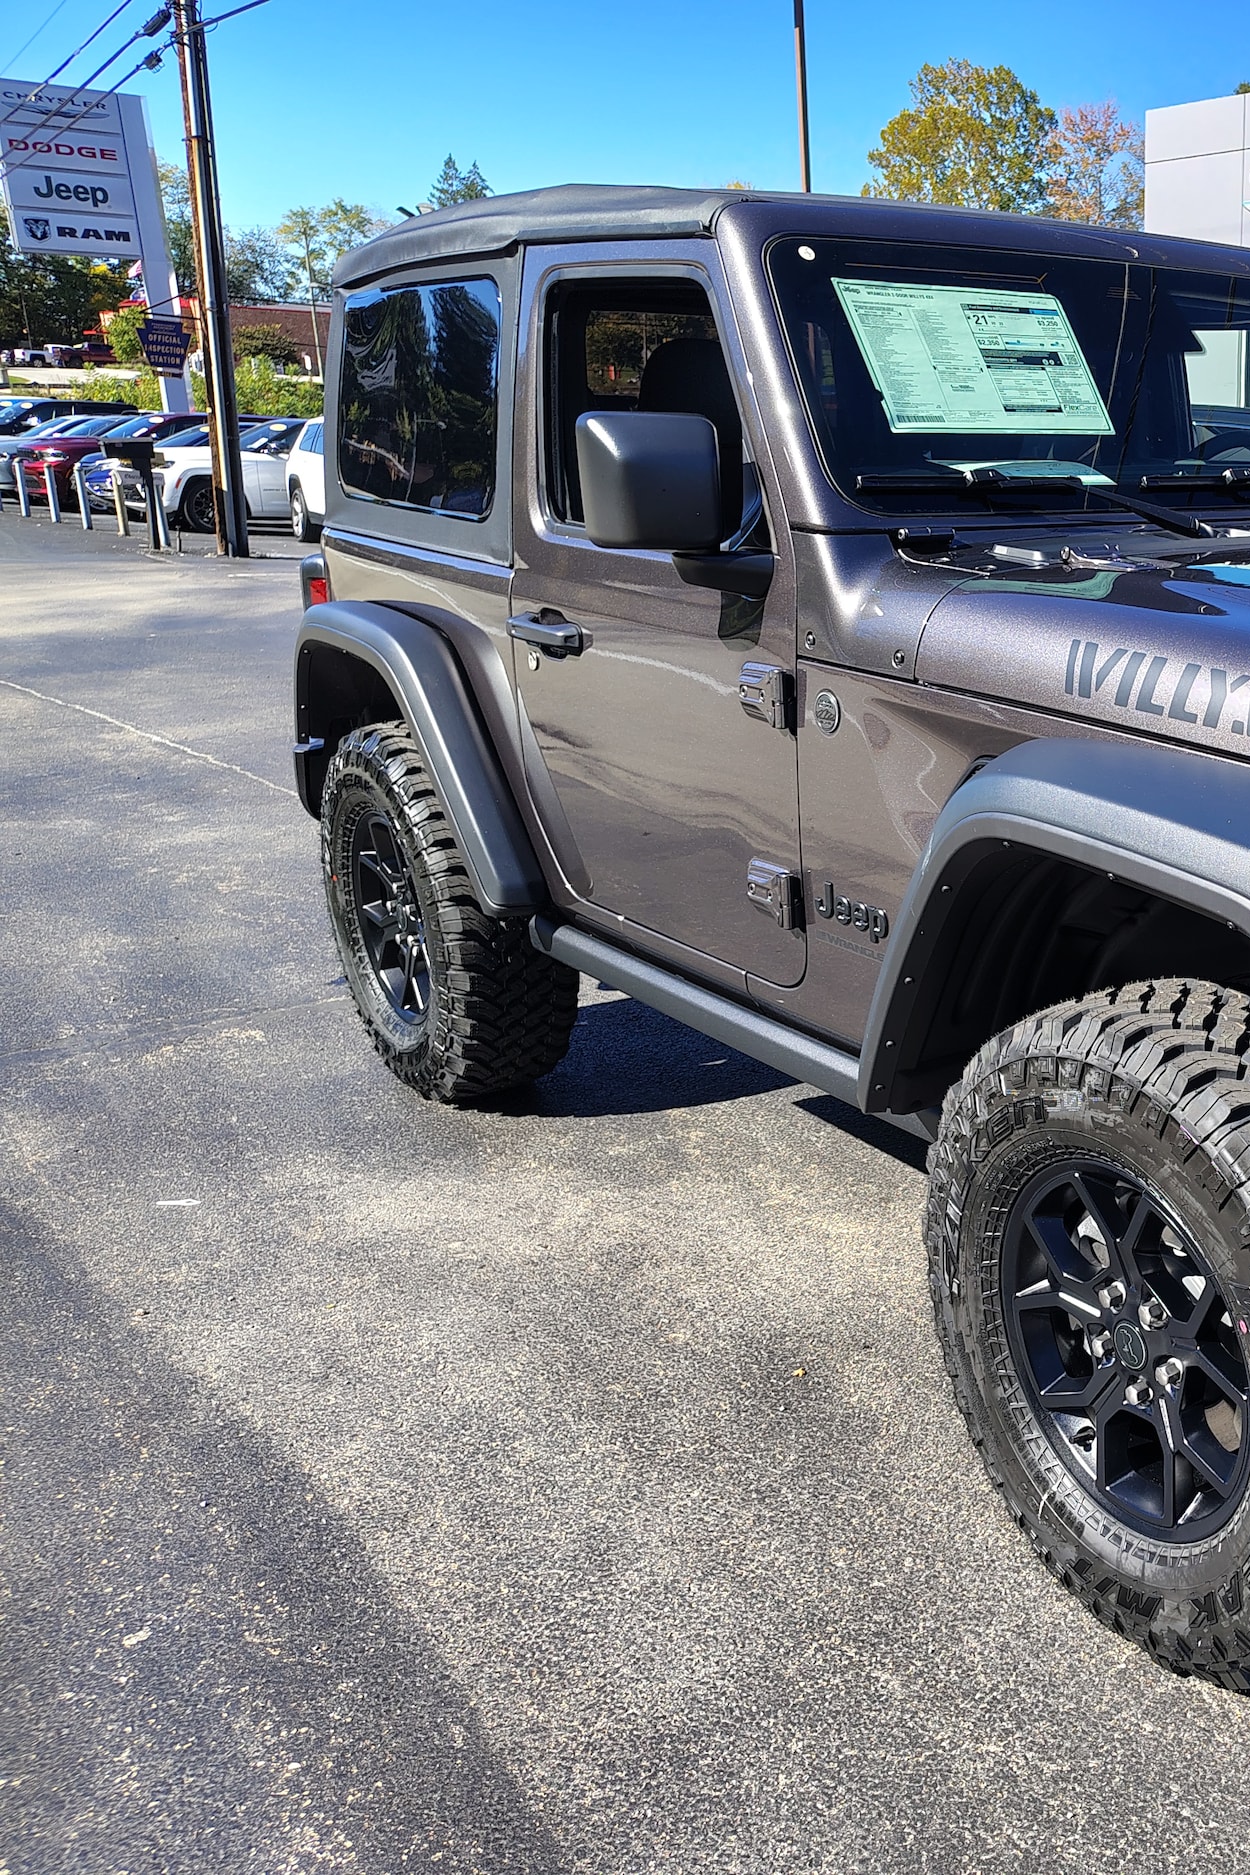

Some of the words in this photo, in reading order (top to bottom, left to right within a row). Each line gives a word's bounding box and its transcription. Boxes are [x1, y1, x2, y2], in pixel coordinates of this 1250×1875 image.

[7, 138, 118, 161] DODGE
[33, 175, 109, 208] Jeep
[56, 226, 131, 243] RAM
[973, 315, 988, 325] 21
[148, 333, 182, 345] OFFICIAL
[144, 343, 185, 355] INSPECTION
[150, 354, 181, 365] STATION
[814, 881, 889, 944] Jeep
